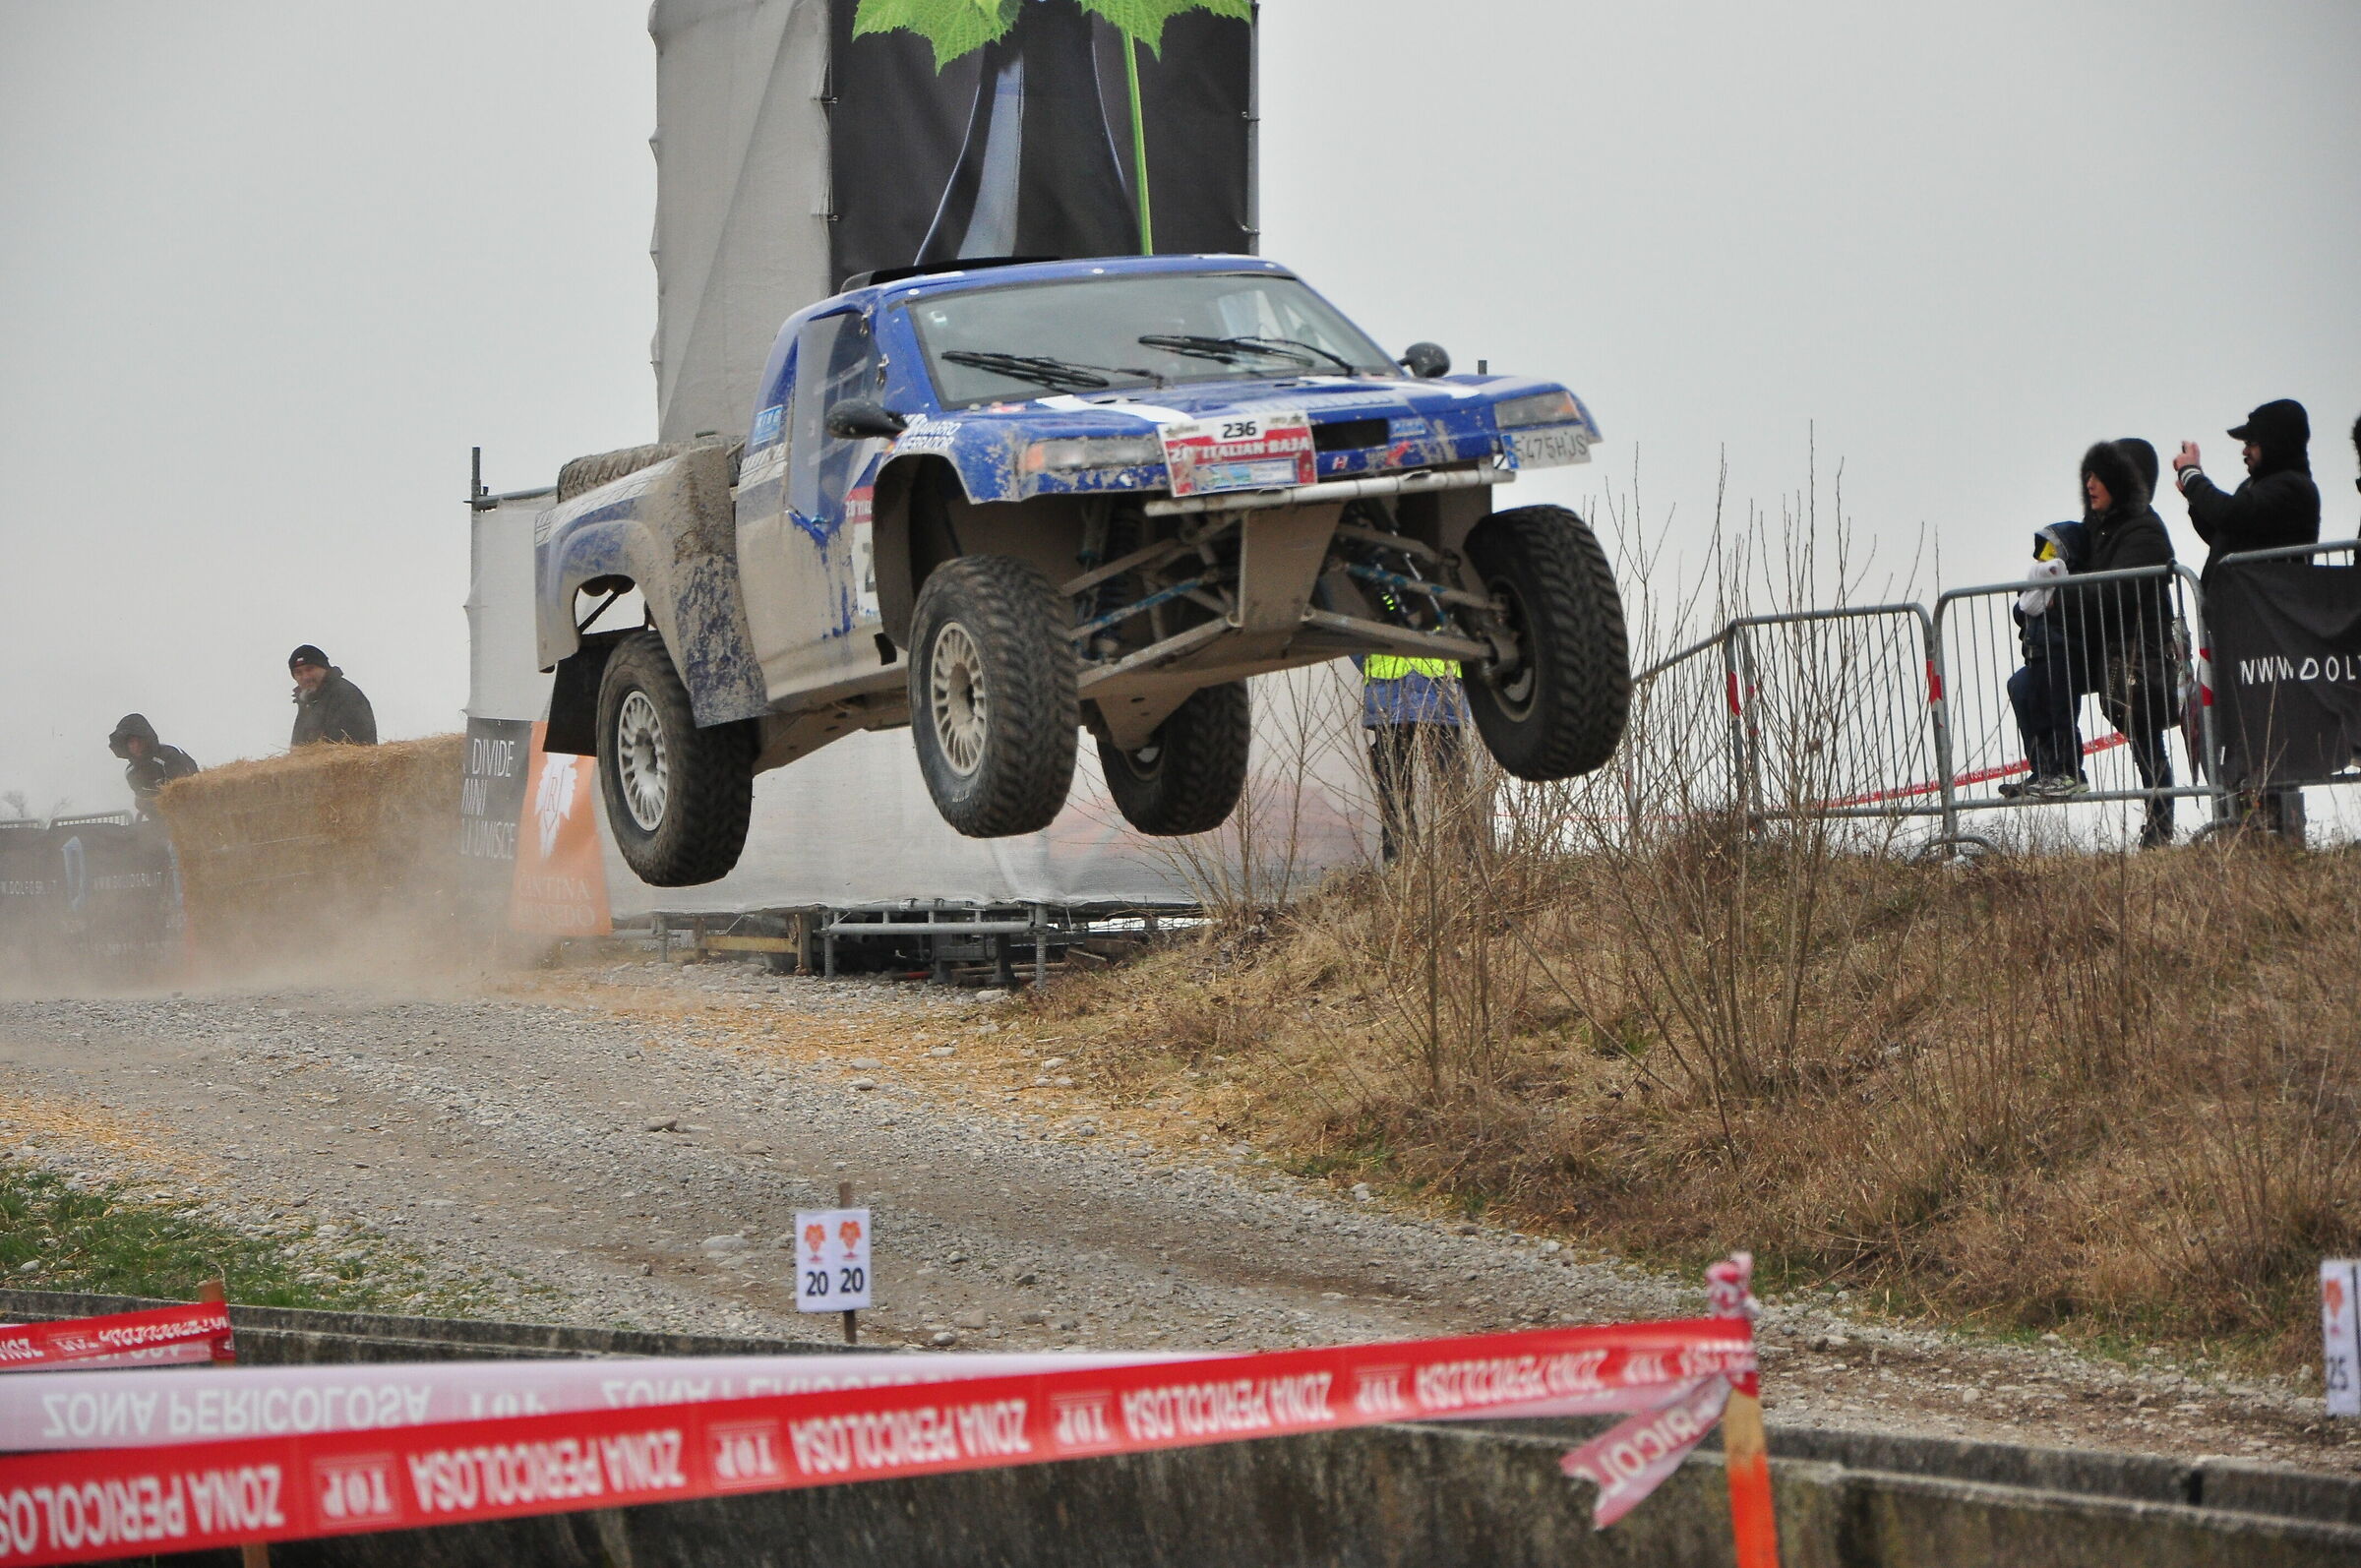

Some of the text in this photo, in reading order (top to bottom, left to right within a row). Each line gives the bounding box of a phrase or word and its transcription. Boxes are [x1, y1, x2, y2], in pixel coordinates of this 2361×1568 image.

[1202, 441, 1265, 459] ITALIAN
[1268, 436, 1310, 453] BAJA
[1223, 421, 1256, 439] 236
[472, 738, 515, 778] DIVIDE
[807, 1266, 865, 1297] 20 20
[1120, 1379, 1271, 1442] PERICOLOSA
[1268, 1371, 1336, 1424] ZONA
[788, 1405, 959, 1476] PERICOLOSA
[956, 1398, 1033, 1457] ZONA
[405, 1436, 603, 1514] PERICOLOSA
[599, 1427, 687, 1493] ZONA
[185, 1463, 285, 1534] ZONA
[321, 1465, 393, 1519] TOP
